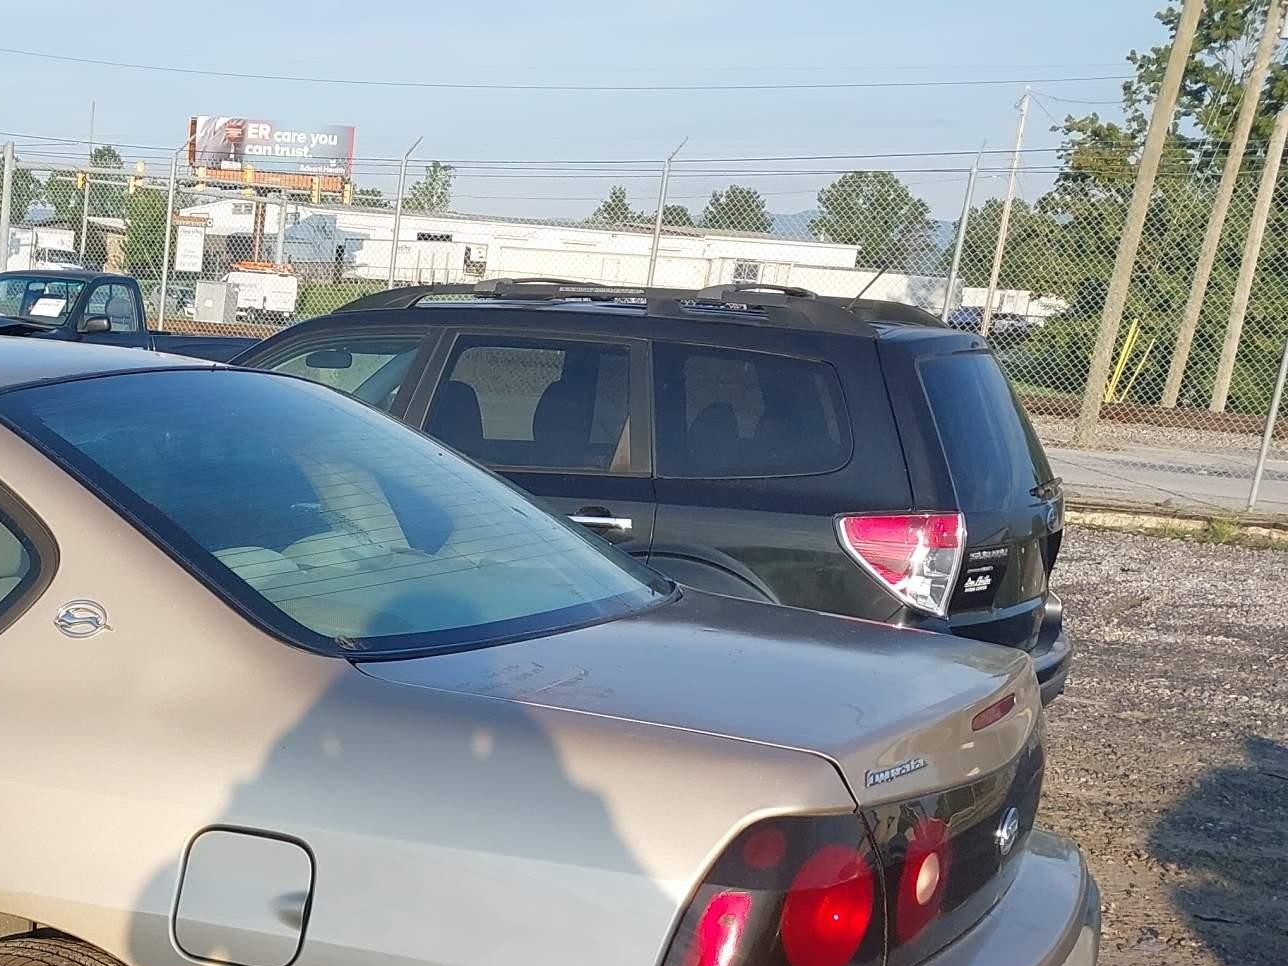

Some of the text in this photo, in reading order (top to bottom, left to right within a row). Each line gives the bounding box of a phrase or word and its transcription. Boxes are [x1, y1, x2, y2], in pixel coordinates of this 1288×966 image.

[247, 122, 338, 149] ER care you
[244, 143, 313, 159] can trust.
